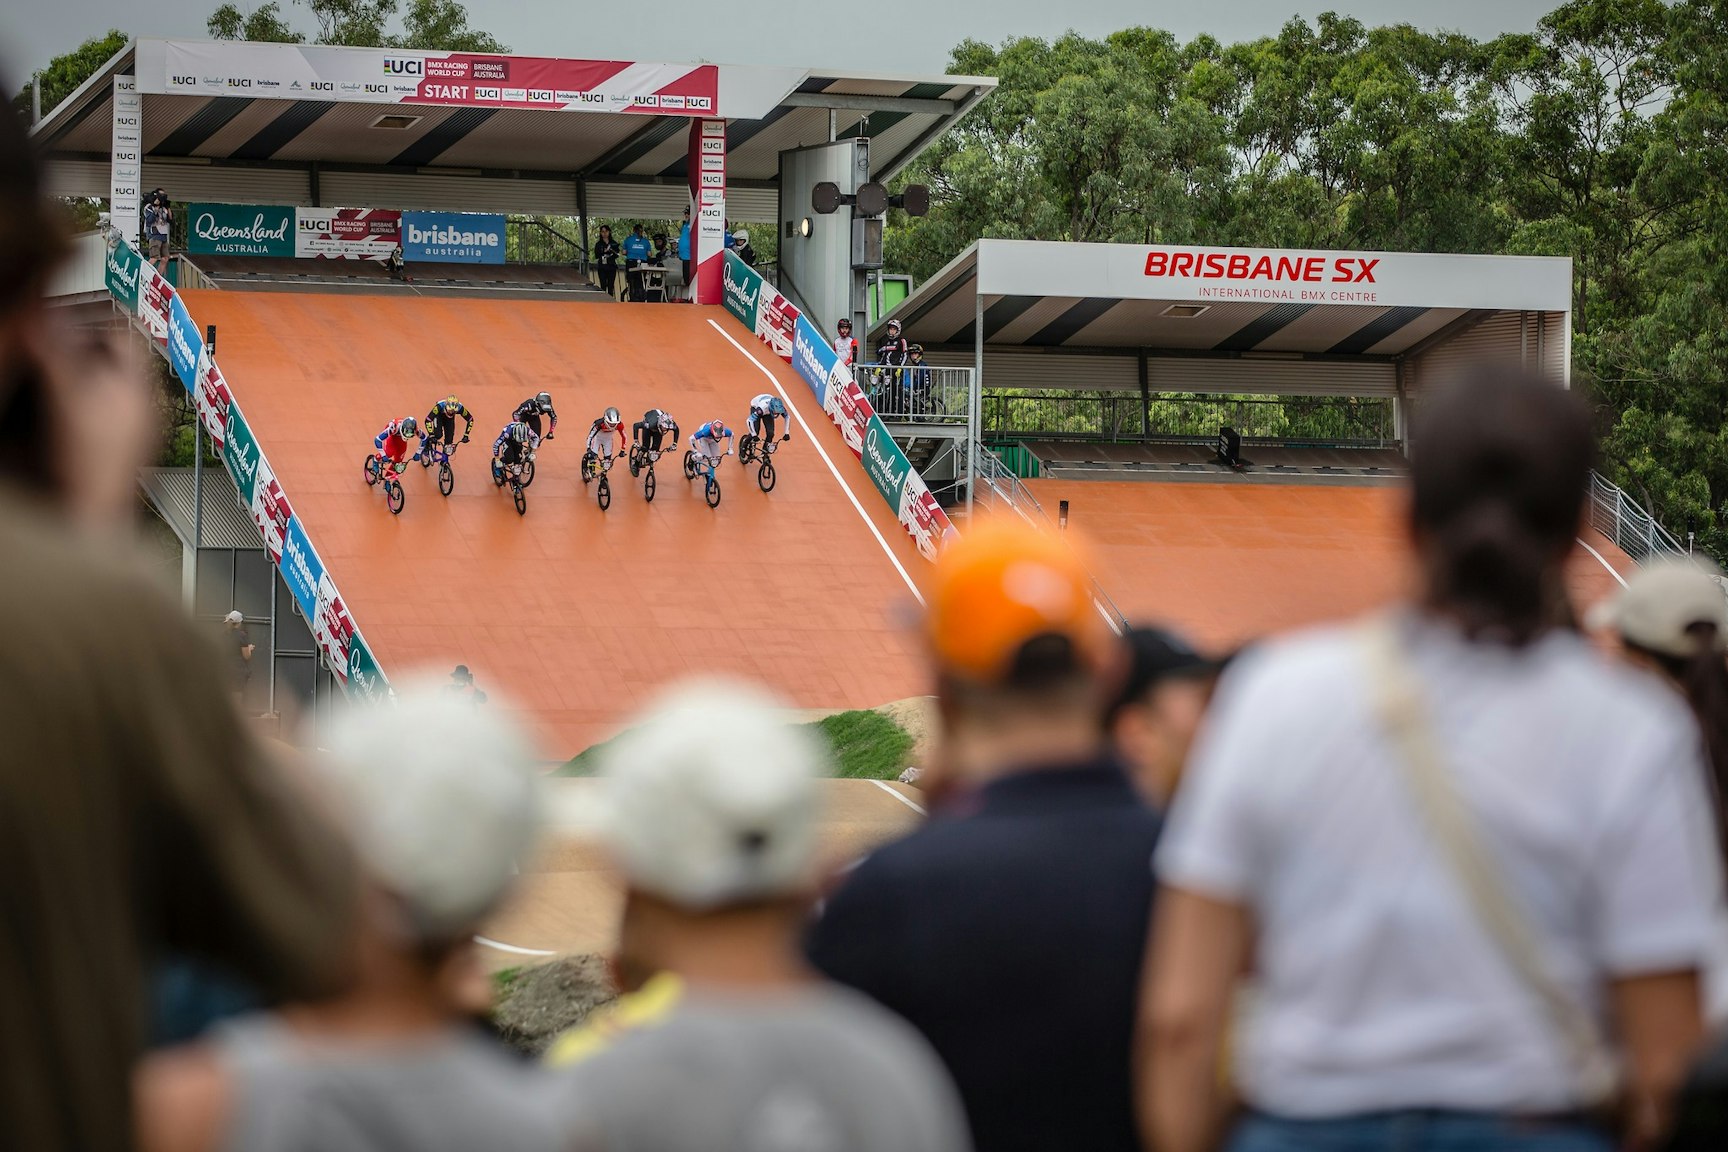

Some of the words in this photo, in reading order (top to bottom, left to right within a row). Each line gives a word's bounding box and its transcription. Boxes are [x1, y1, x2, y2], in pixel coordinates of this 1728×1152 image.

[391, 60, 422, 74] UCI
[443, 62, 468, 70] RACING
[473, 63, 503, 71] BRISBANE
[473, 71, 506, 79] AUSTRALIA
[177, 76, 196, 85] UCI
[232, 78, 251, 87] UCI
[315, 82, 333, 91] UCI
[369, 84, 388, 93] UCI
[424, 84, 469, 99] START
[479, 89, 498, 98] UCI
[533, 91, 551, 100] UCI
[586, 94, 604, 103] UCI
[638, 96, 657, 105] UCI
[691, 98, 709, 107] UCI
[195, 213, 288, 242] Queensland
[306, 220, 329, 231] UCI
[408, 224, 499, 247] brisbane
[215, 244, 269, 253] AUSTRALIA
[425, 248, 482, 257] australia
[1144, 252, 1326, 282] BRISBANE
[1331, 258, 1380, 283] SX
[723, 262, 758, 311] Queensland
[1199, 287, 1295, 300] INTERNATIONAL
[1302, 290, 1326, 301] BMX
[1331, 291, 1376, 302] CENTRE
[169, 308, 196, 370] brisbane
[796, 329, 828, 385] brisbane
[227, 415, 256, 482] Queensland
[867, 429, 904, 493] Queensland
[870, 464, 890, 497] AUSTRALIA
[286, 530, 318, 598] brisbane
